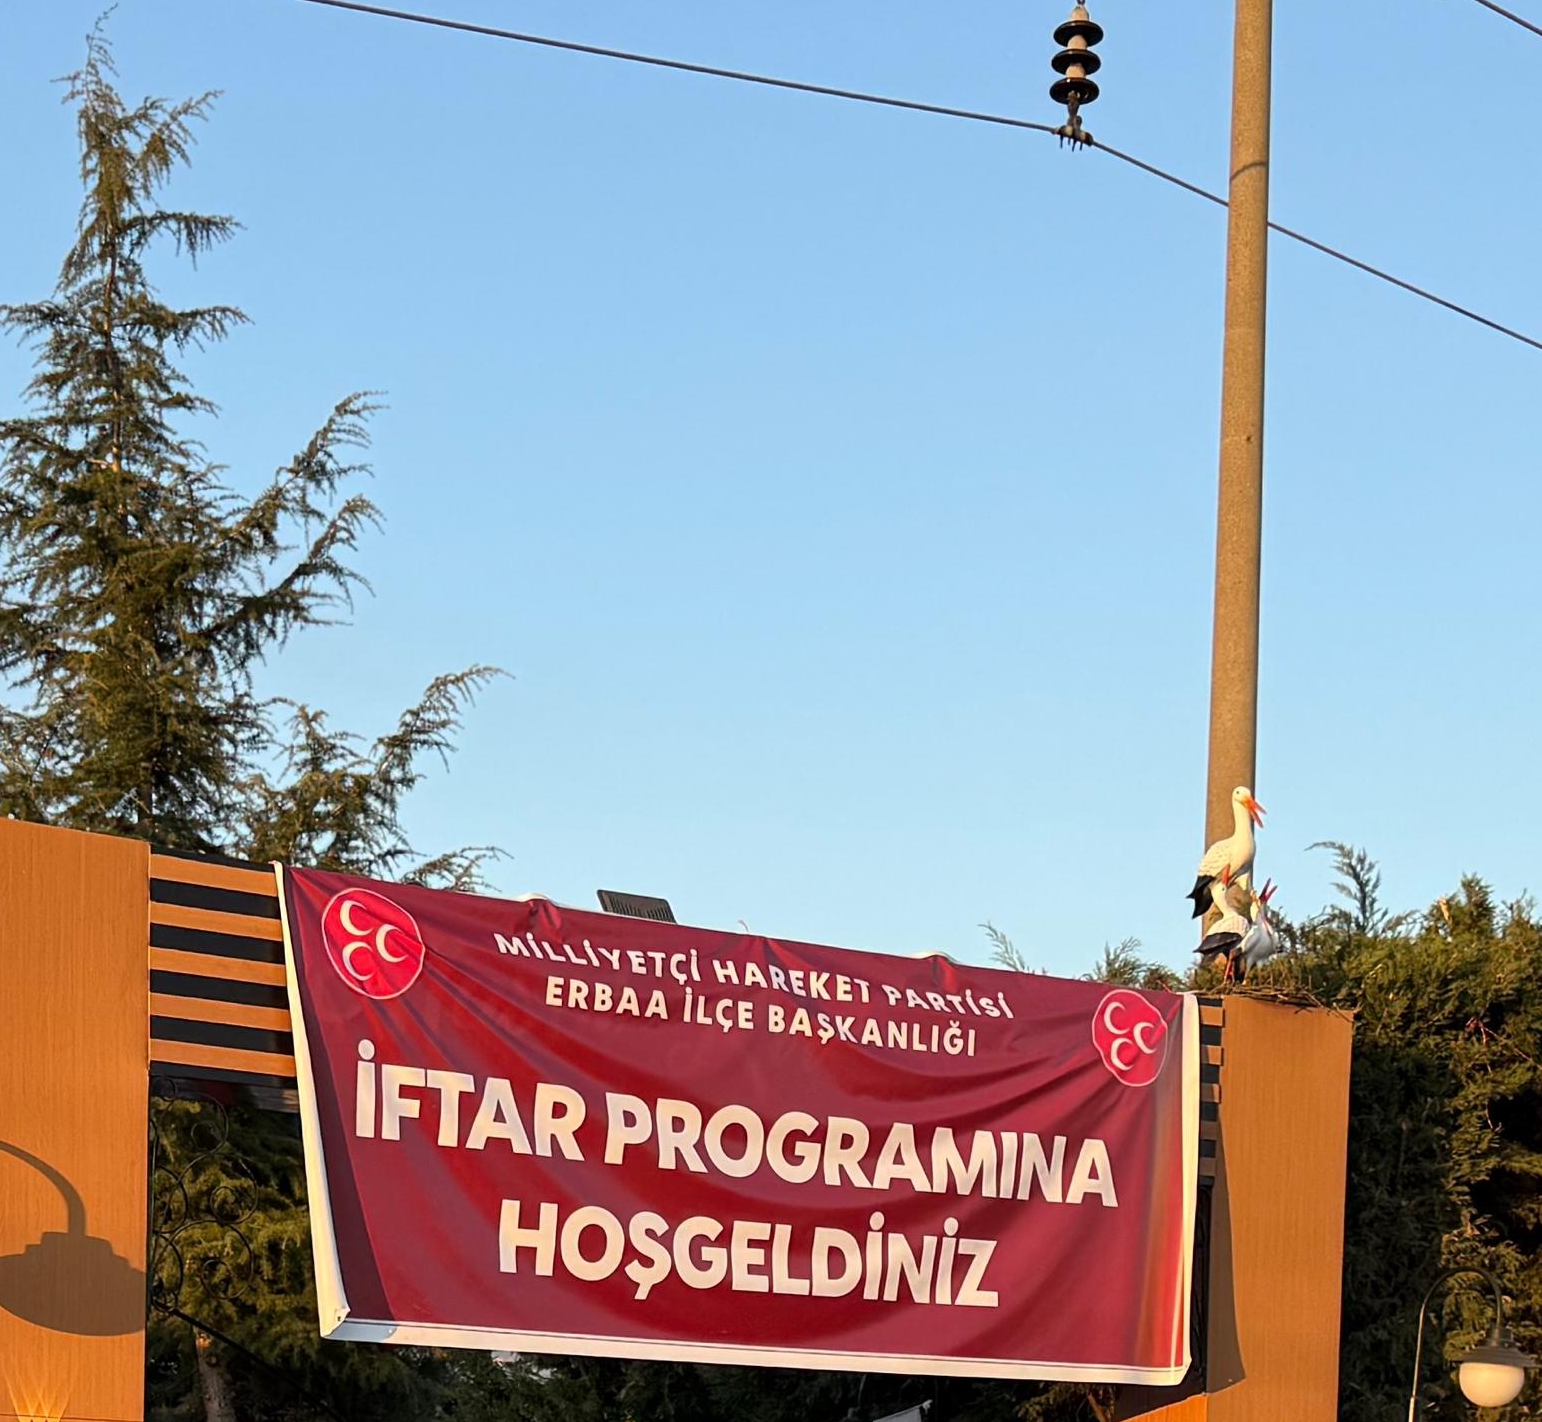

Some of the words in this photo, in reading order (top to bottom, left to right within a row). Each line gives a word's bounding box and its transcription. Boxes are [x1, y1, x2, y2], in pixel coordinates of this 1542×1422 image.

[493, 932, 701, 985] MİLLİYETÇİ
[712, 959, 870, 1003] HAREKET
[881, 984, 1014, 1019] PARTİSİ
[545, 976, 669, 1020] ERBAA
[683, 986, 754, 1033] İLÇE
[768, 1004, 976, 1057] BAŞKANLIĞI
[355, 1038, 587, 1162] İFTAR
[604, 1091, 1119, 1208] PROGRAMINA
[498, 1199, 999, 1308] HOŞGELDİNİZ
